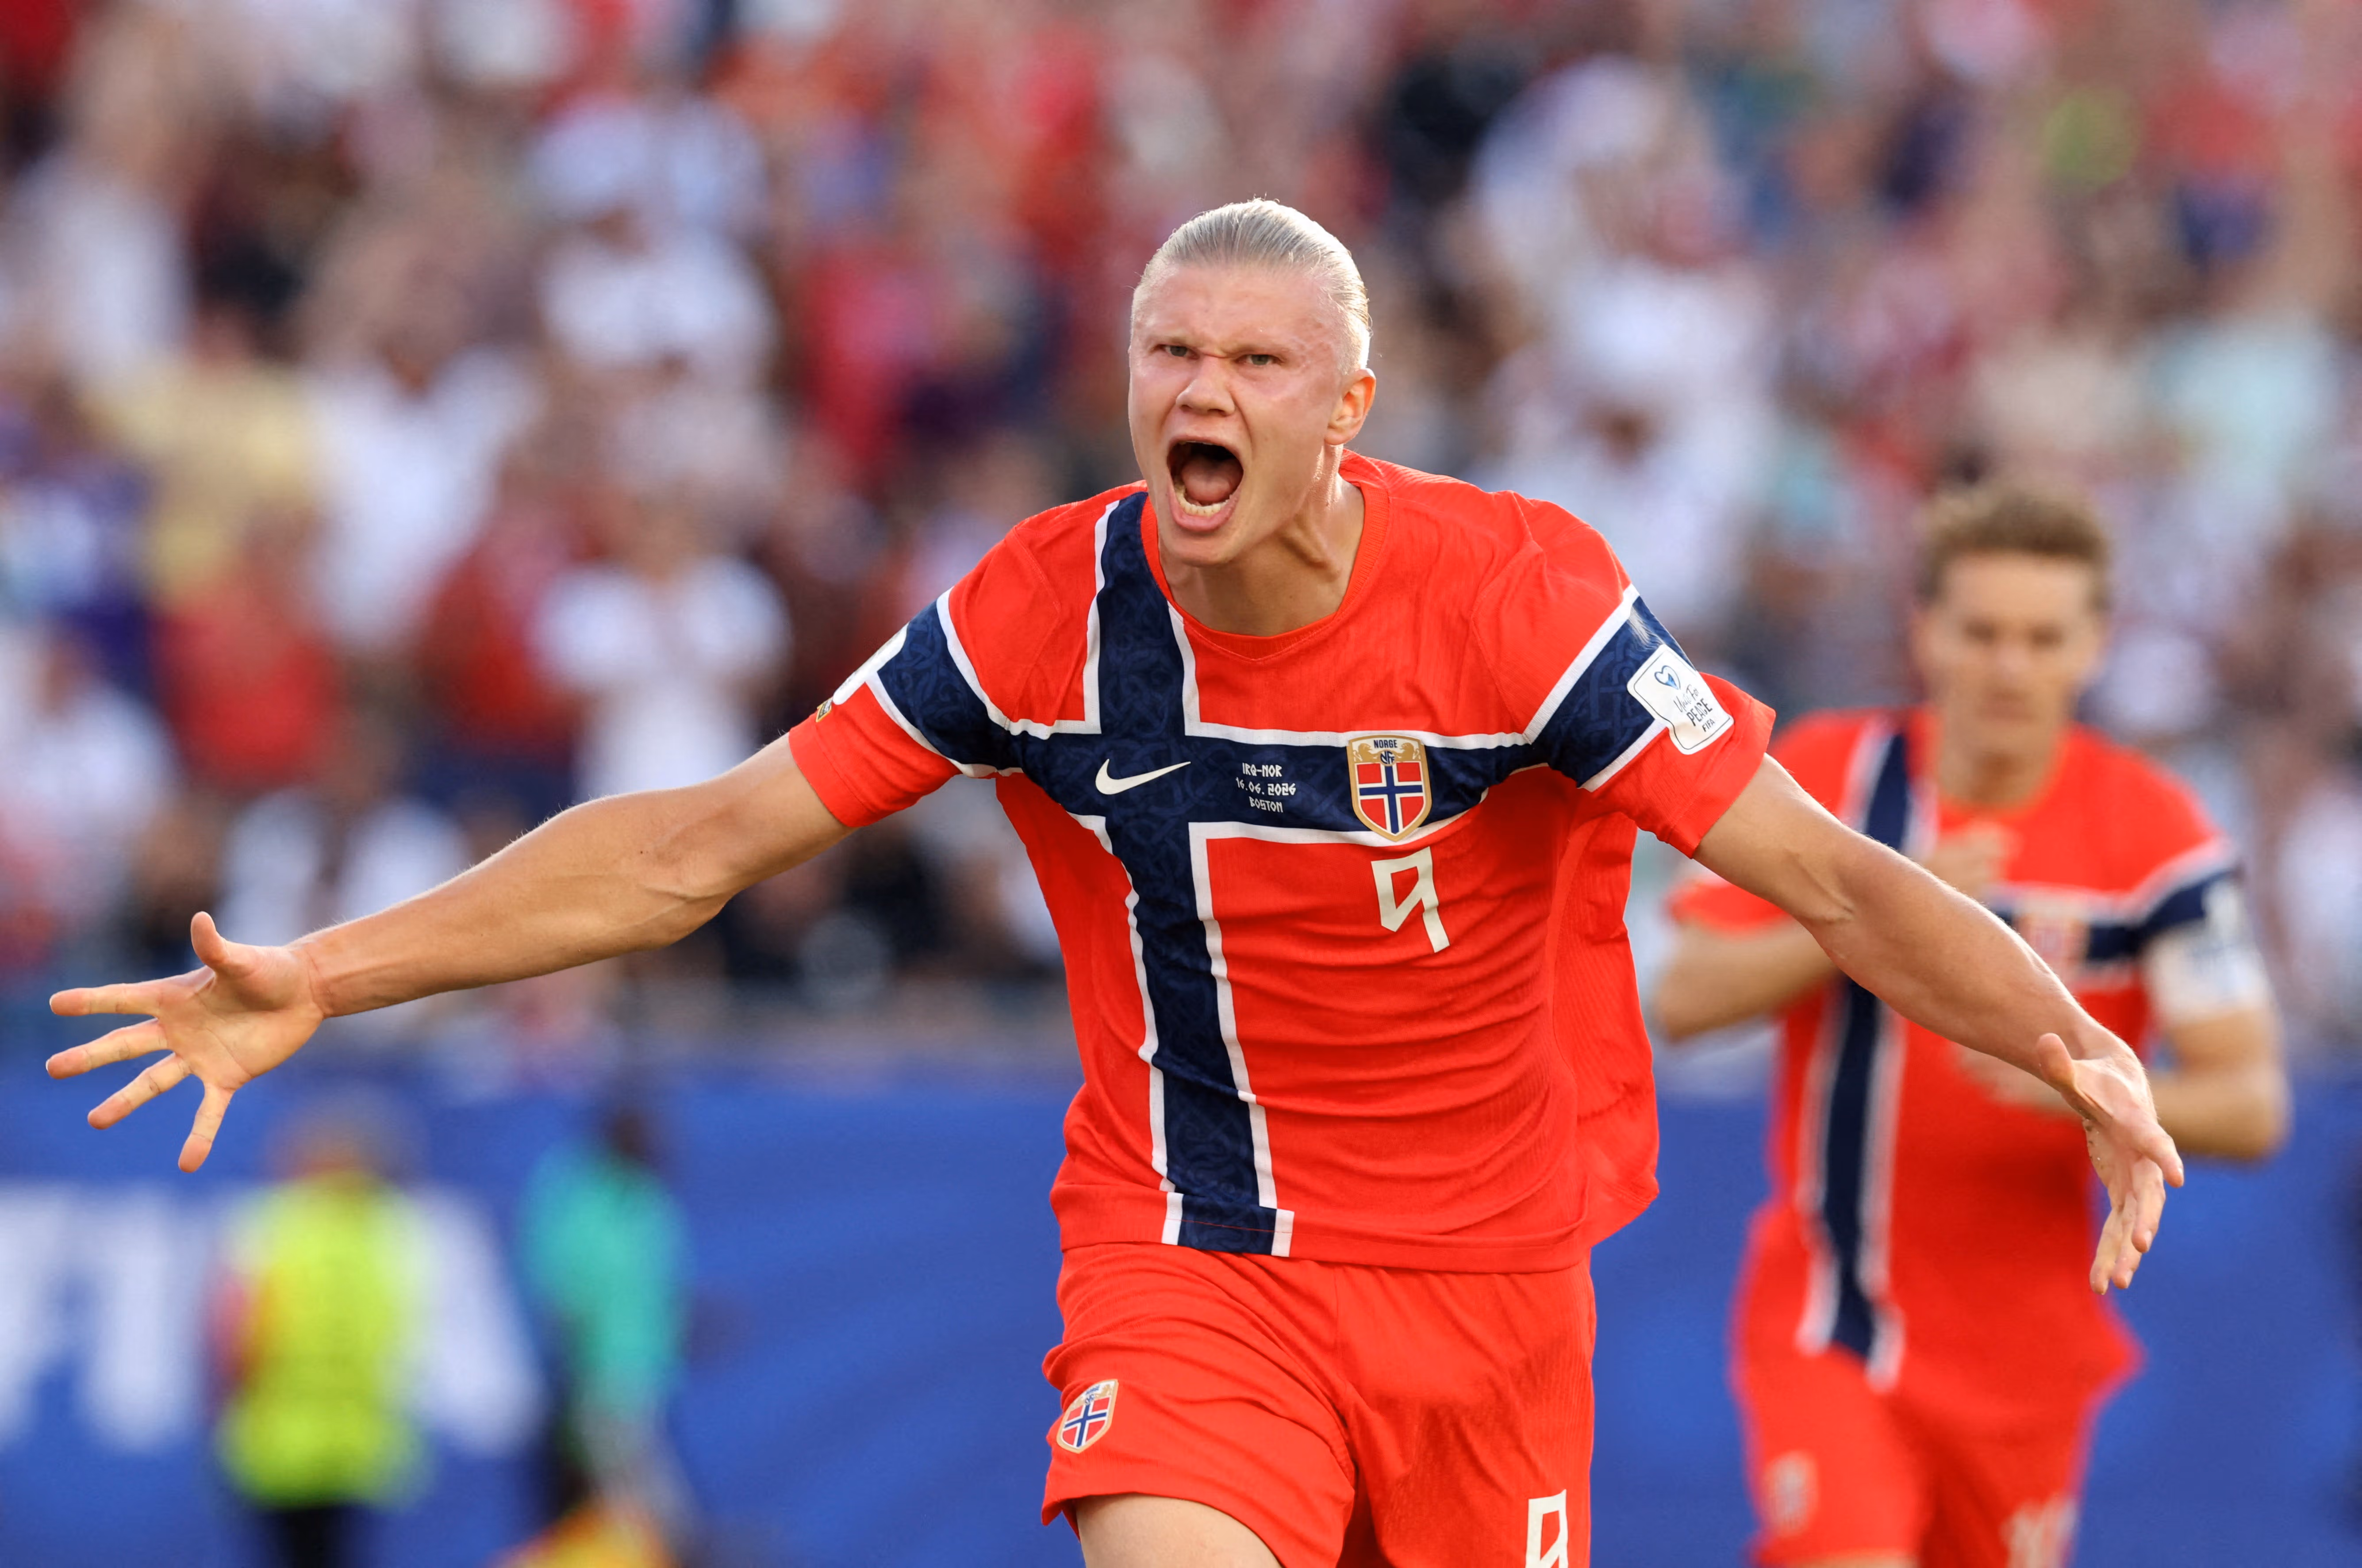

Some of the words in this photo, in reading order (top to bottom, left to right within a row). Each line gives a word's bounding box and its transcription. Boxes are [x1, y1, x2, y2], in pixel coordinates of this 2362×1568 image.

[1686, 698, 1713, 727] PEACE
[1702, 719, 1716, 732] FIFA
[1374, 740, 1398, 748] NORGE
[1242, 762, 1283, 778] IRQ-NOR
[1249, 796, 1283, 813] BOSTON
[1371, 846, 1450, 953] 9
